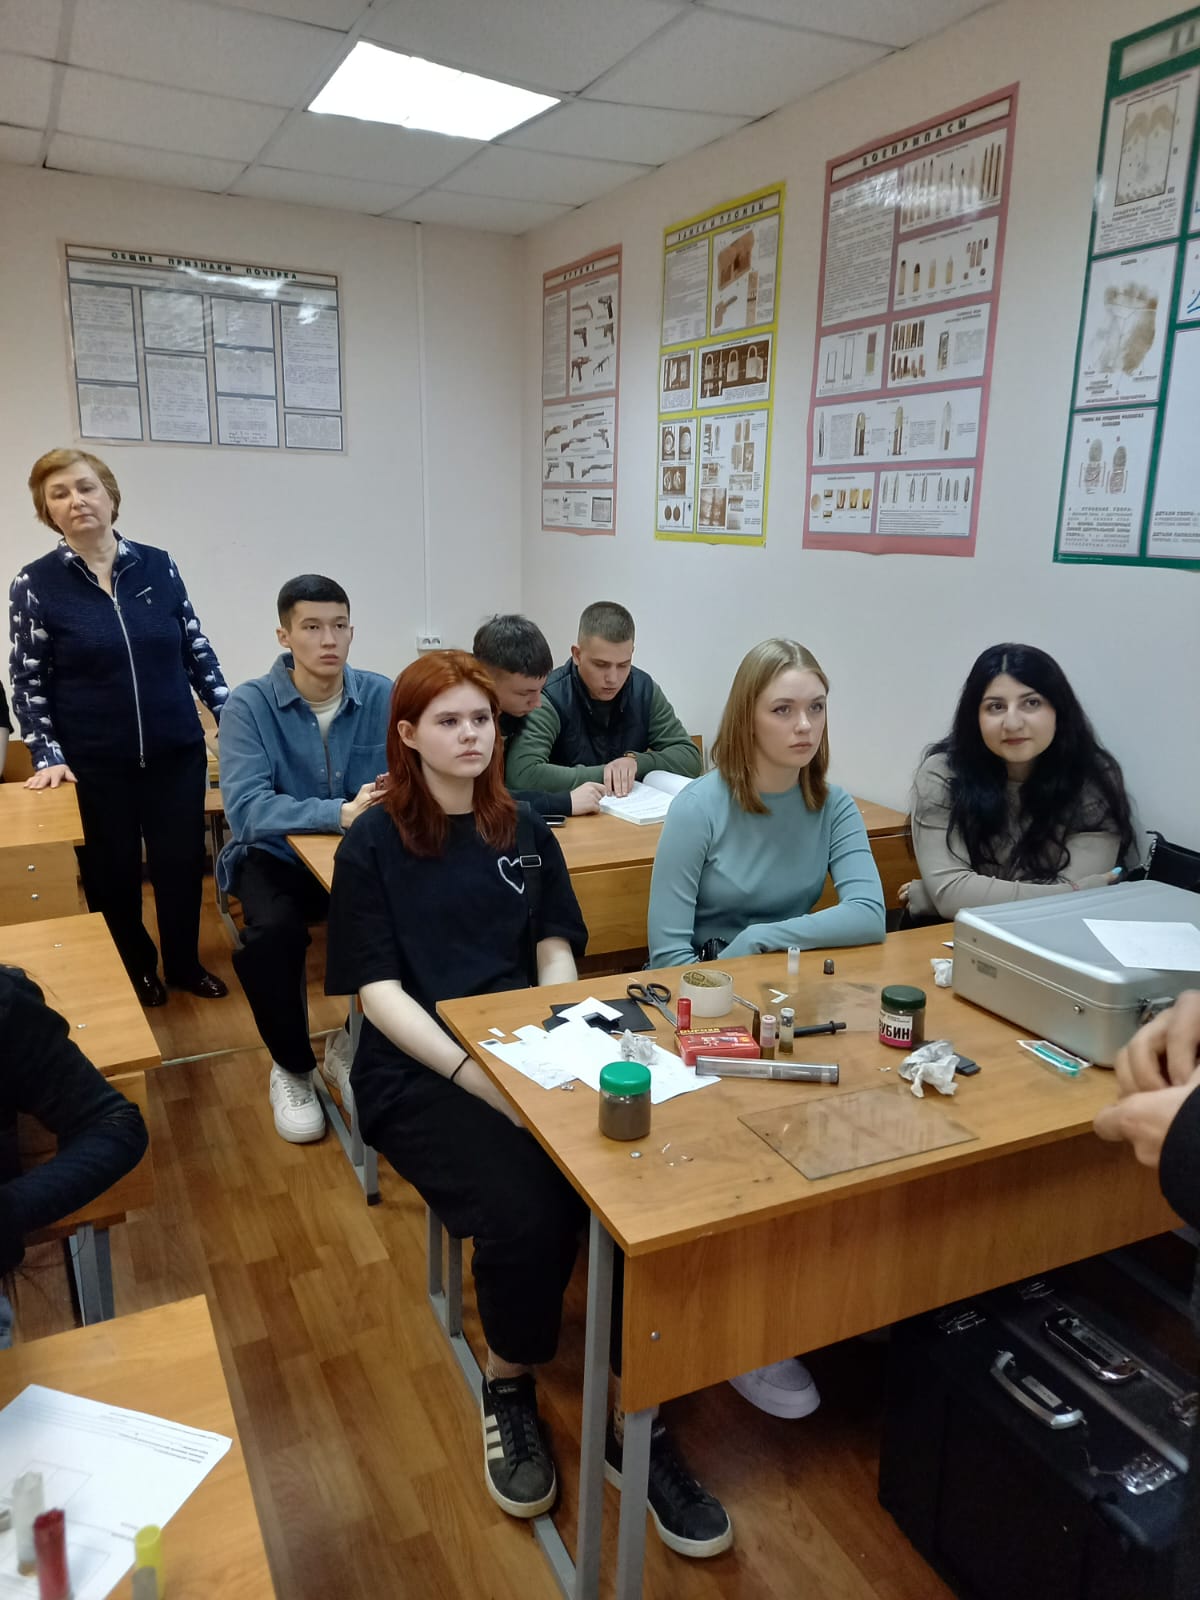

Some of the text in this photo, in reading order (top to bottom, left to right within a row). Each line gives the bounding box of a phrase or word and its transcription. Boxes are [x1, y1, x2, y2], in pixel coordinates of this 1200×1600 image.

[862, 117, 967, 167] БОЕПРИПАСЫ
[111, 251, 297, 281] ОБЩИЕ ПРИЗНАКИ ПОЧЕРКА
